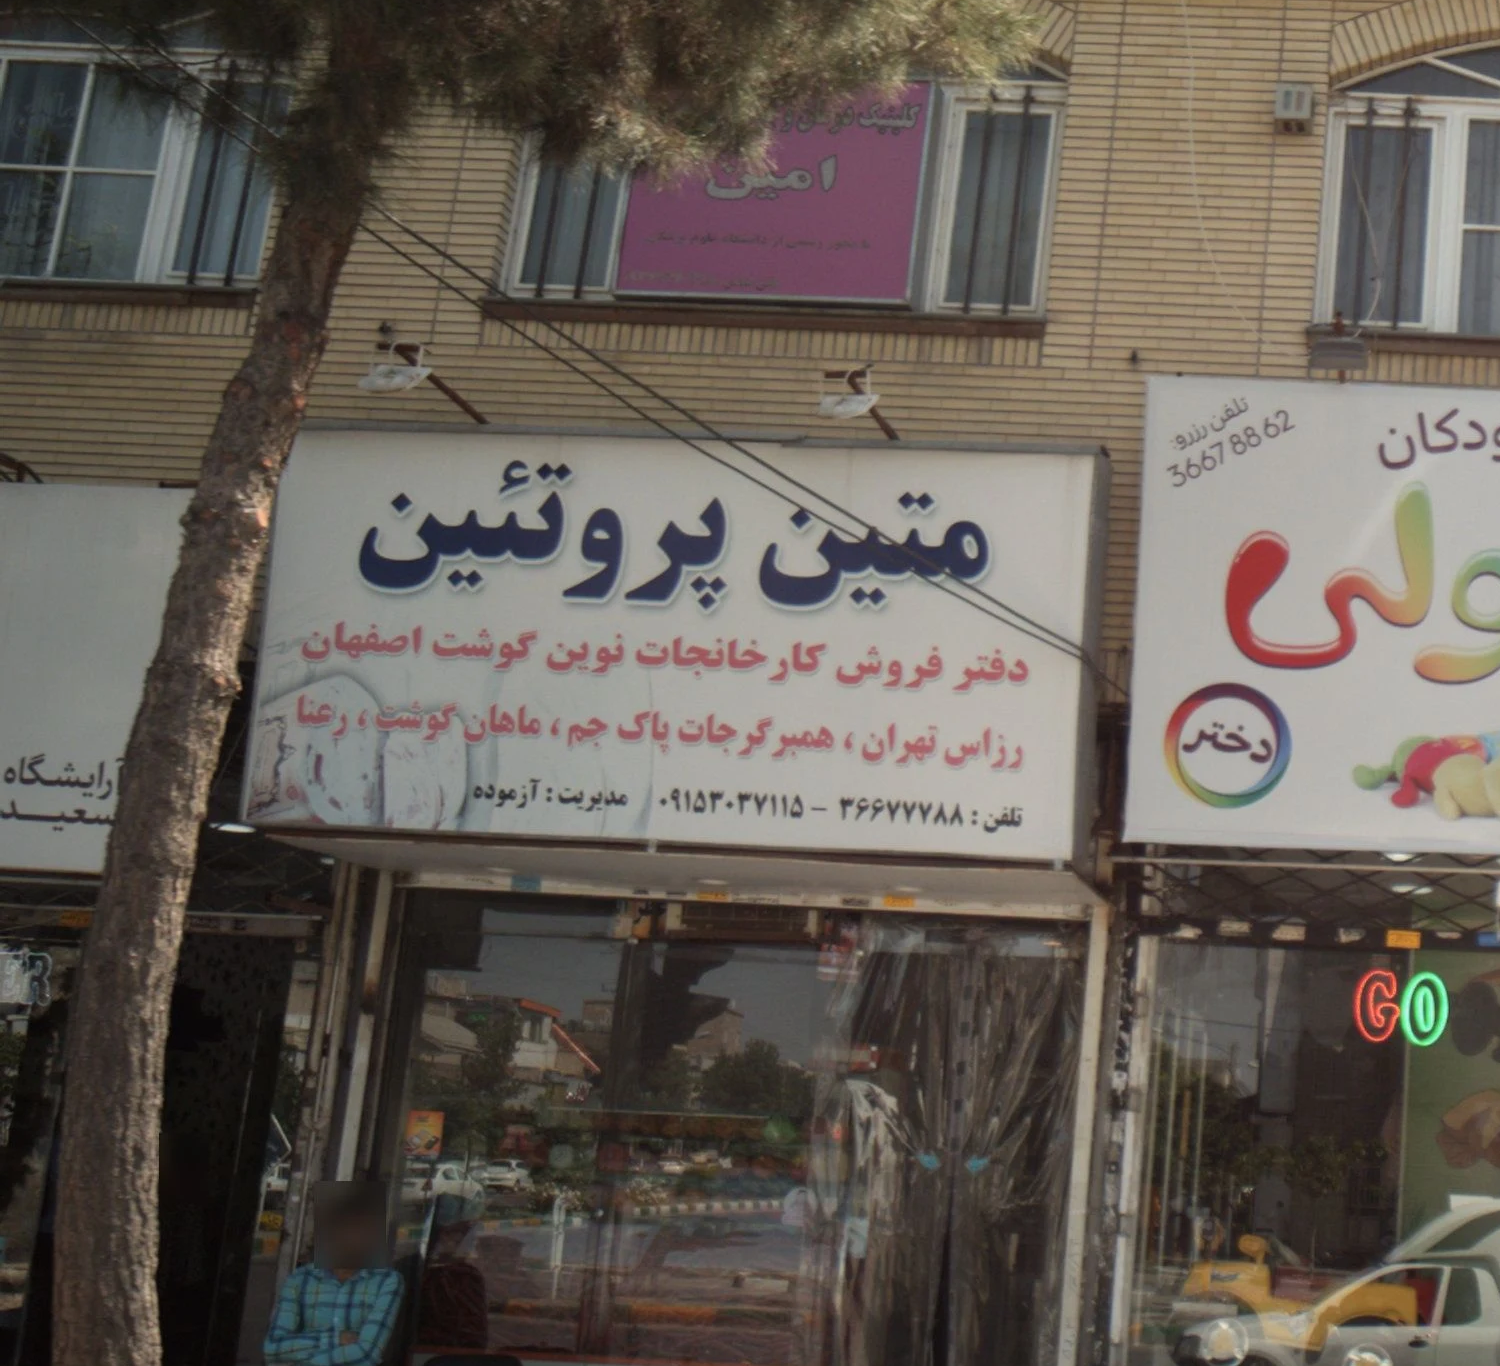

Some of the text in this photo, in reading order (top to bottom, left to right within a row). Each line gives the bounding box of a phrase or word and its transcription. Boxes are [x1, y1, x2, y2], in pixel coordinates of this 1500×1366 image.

[705, 154, 838, 201] امین
[1210, 396, 1249, 432] تلفن
[357, 460, 990, 611] متین پروتئین
[301, 621, 1029, 692] دفتر فروش کارخانجات نوین گوشت اصفهان
[295, 694, 348, 739] رعنا
[375, 700, 457, 742] گوشت
[463, 704, 541, 743] ماهان
[567, 717, 608, 748] جم
[617, 710, 669, 754] پاک
[861, 723, 938, 765] تهران
[1181, 721, 1273, 764] دختر
[473, 778, 541, 809] آزموده
[659, 787, 804, 819] ۰۹۱۵۳۰۳۷۱۱۵
[840, 797, 963, 827] ۳۶۶۷۷۷۸۸
[1353, 969, 1449, 1047] GO
